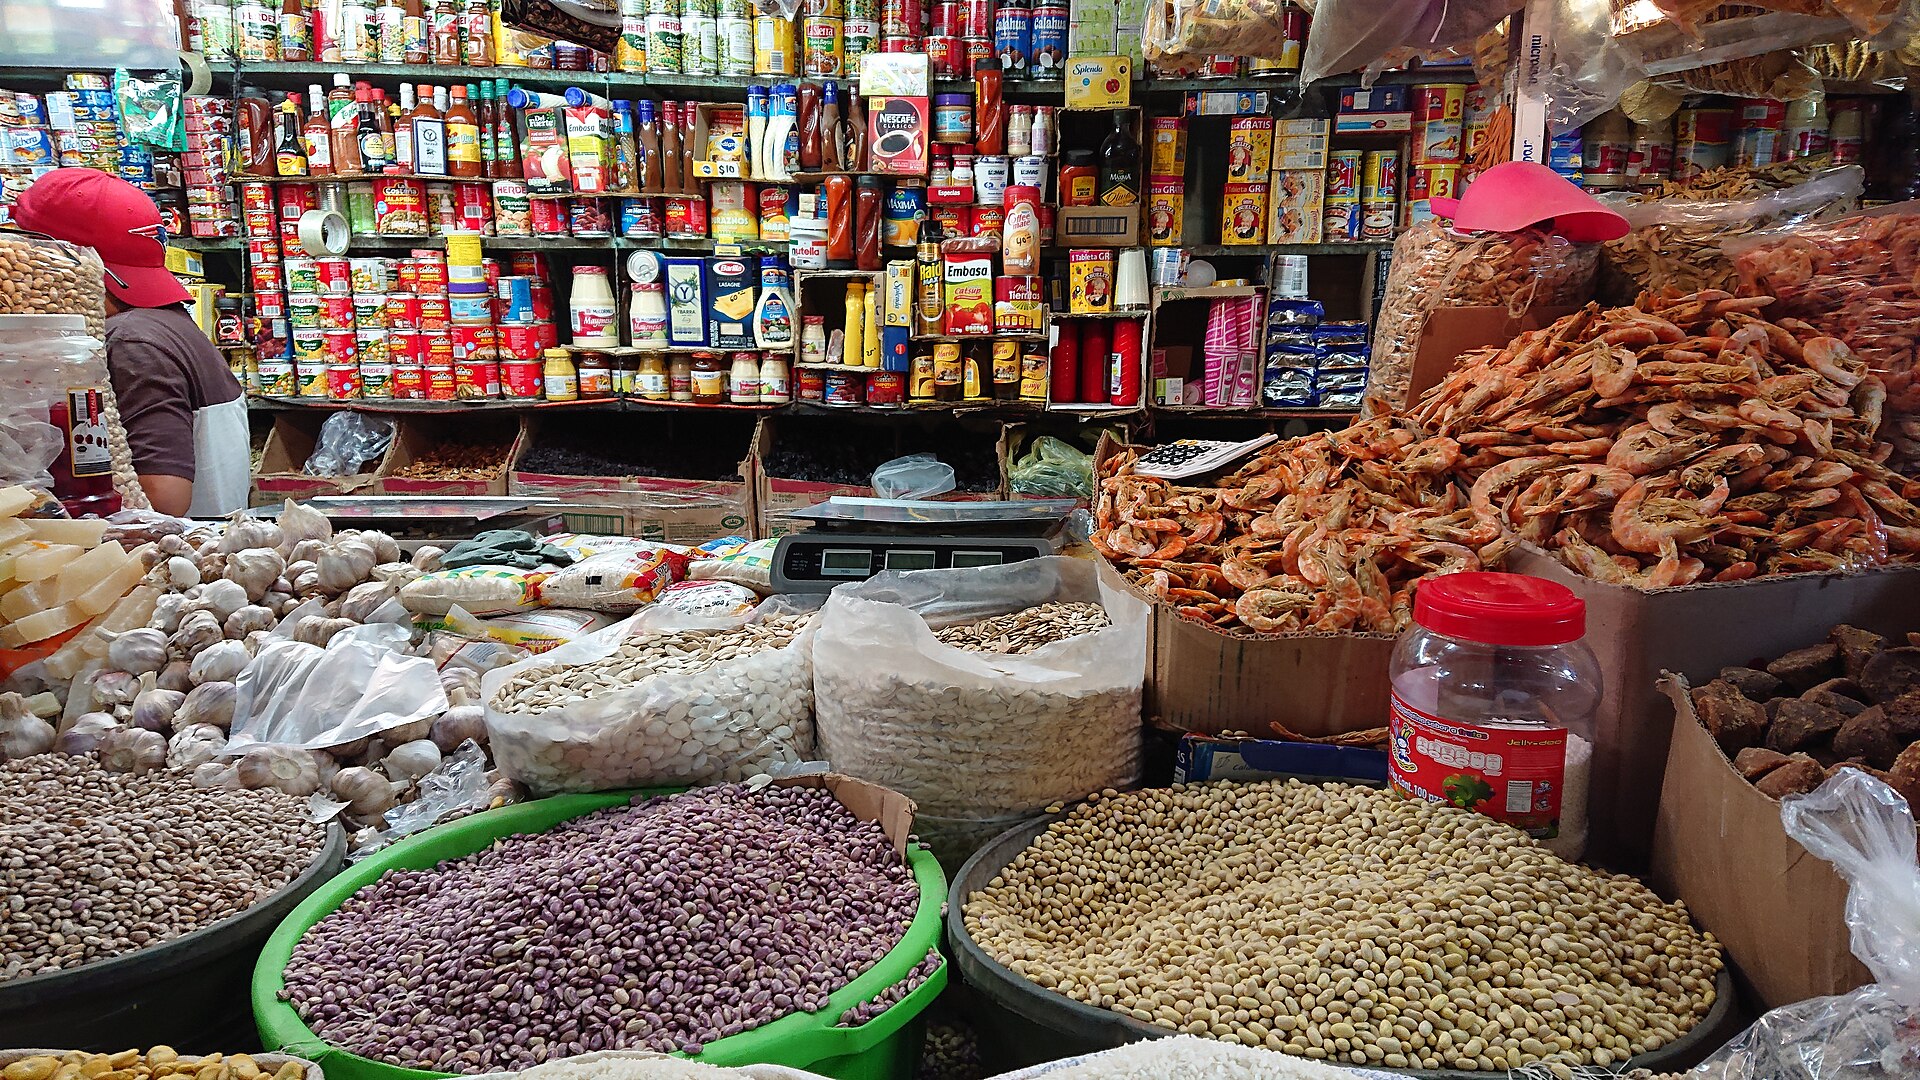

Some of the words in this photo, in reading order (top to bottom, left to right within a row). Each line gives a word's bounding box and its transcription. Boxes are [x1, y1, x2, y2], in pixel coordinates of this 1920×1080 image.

[996, 18, 1027, 31] Calahua
[1035, 17, 1067, 31] Calahua
[1073, 63, 1103, 76] Splenda
[534, 115, 545, 123] Del
[879, 112, 916, 124] NESCAFÉ
[1241, 120, 1271, 132] GRATIS
[719, 165, 735, 175] $10
[791, 247, 820, 257] nutella
[1075, 254, 1097, 263] Tableta
[720, 263, 743, 273] Barilla
[920, 262, 942, 281] Raid
[947, 267, 988, 279] Embasa
[679, 286, 690, 300] Y
[1413, 784, 1427, 799] 100
